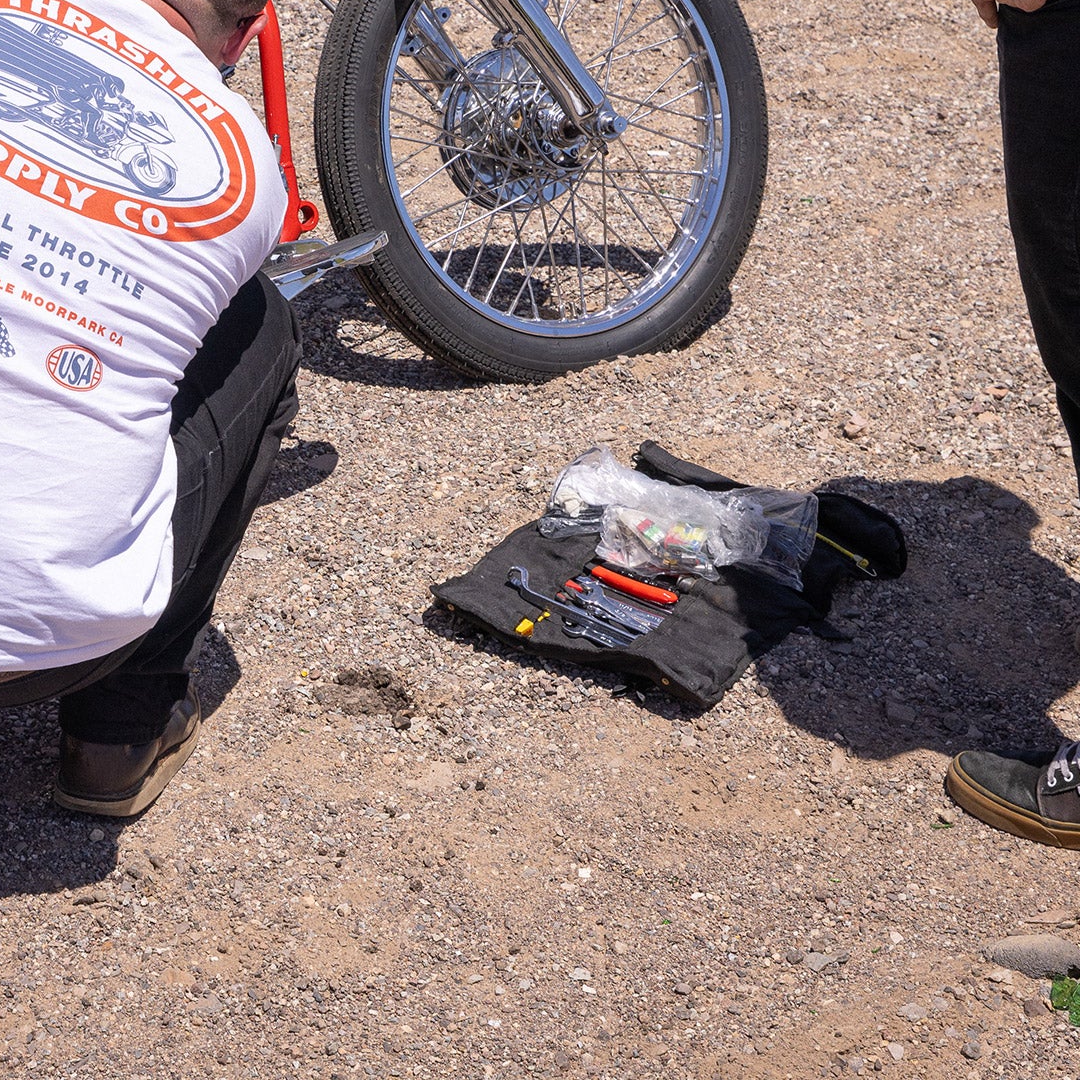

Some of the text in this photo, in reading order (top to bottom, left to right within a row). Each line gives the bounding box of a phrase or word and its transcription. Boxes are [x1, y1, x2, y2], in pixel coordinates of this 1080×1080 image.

[113, 200, 168, 235] CO
[21, 253, 89, 295] 2014
[26, 224, 145, 300] THROTTLE
[20, 291, 107, 337] MOORPARK
[109, 331, 125, 347] CA
[58, 351, 94, 386] USA
